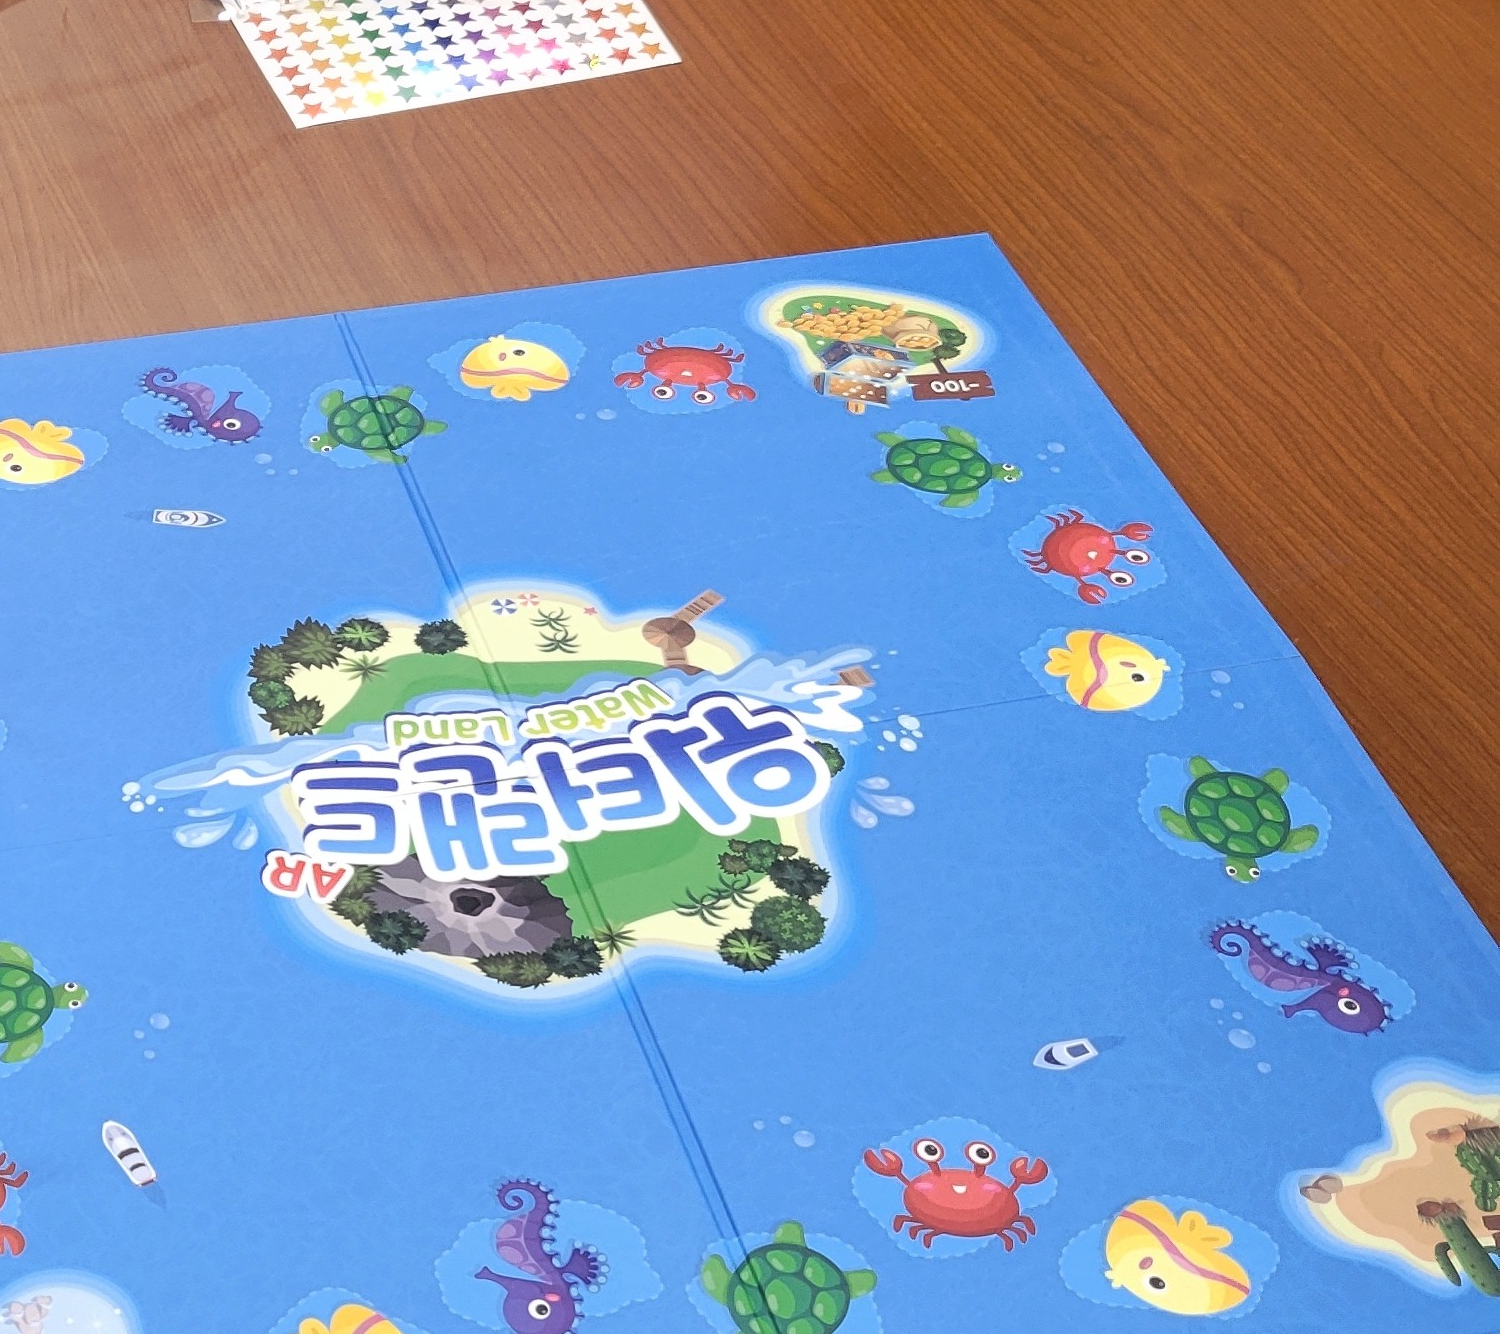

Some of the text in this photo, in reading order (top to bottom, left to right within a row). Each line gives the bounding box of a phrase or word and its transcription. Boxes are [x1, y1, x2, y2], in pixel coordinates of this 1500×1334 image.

[390, 681, 671, 749] Water Land
[297, 695, 822, 875] 워터랜드
[267, 854, 347, 899] AR
